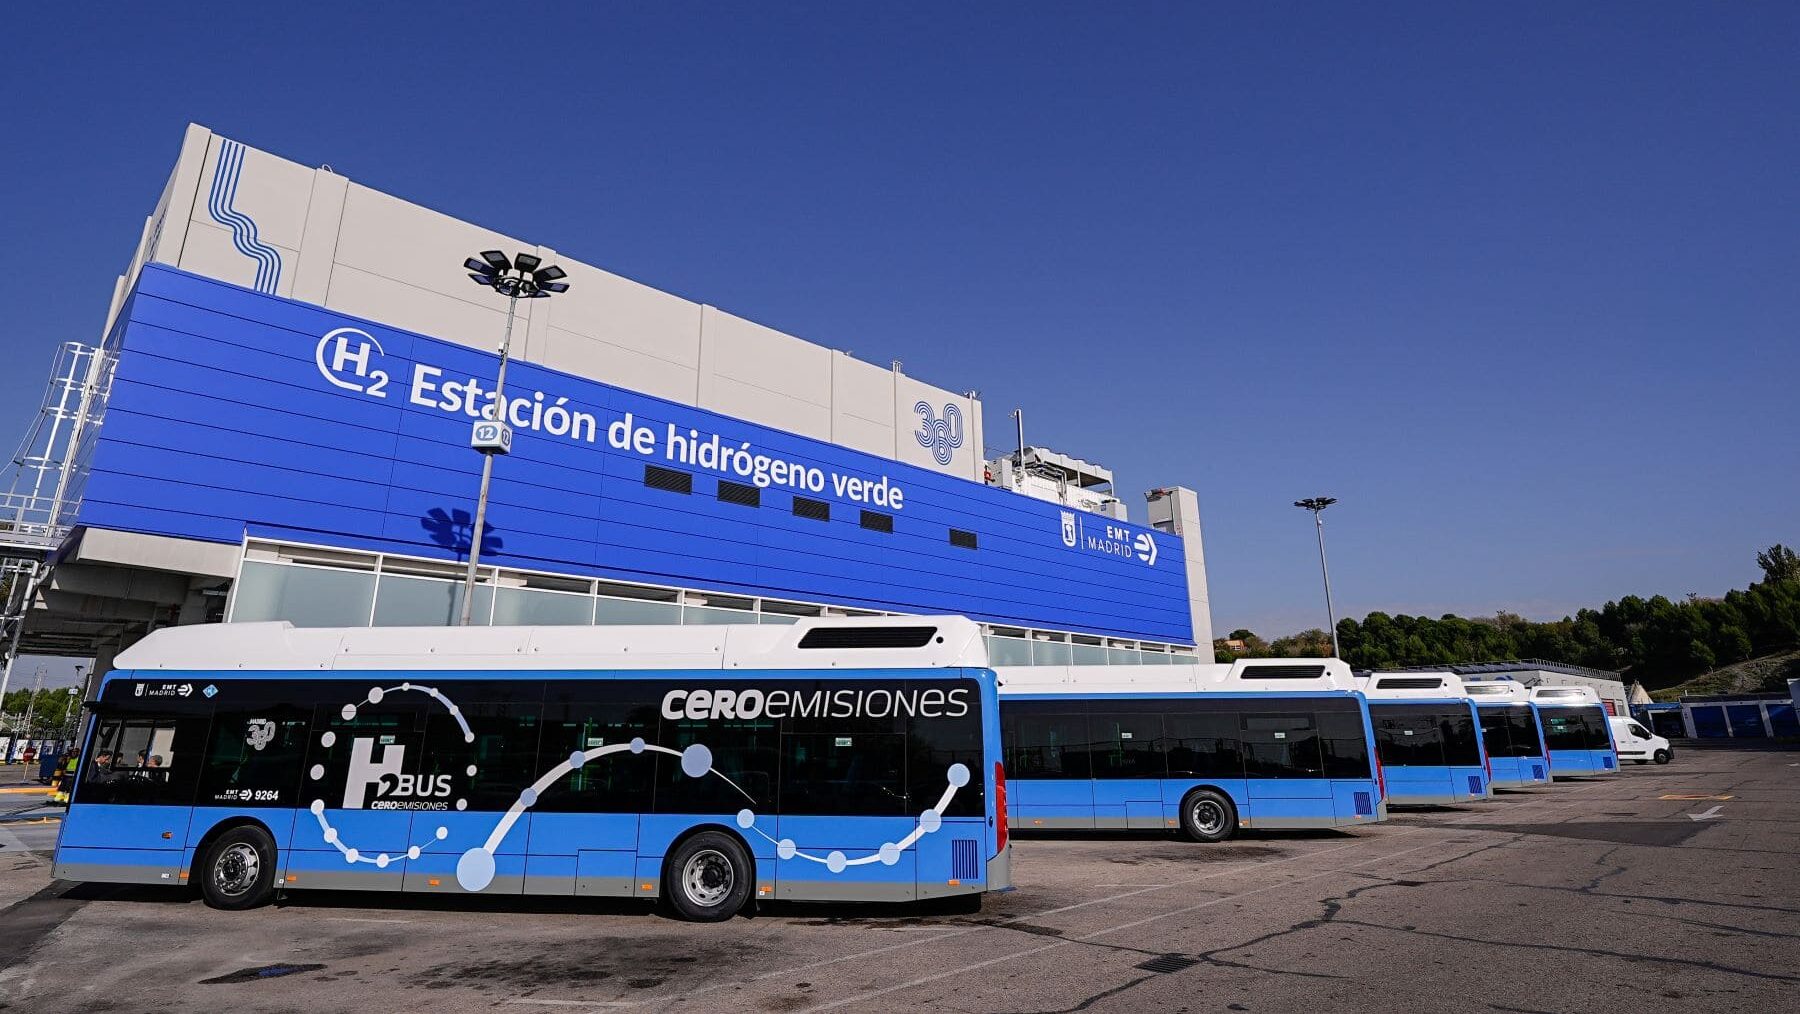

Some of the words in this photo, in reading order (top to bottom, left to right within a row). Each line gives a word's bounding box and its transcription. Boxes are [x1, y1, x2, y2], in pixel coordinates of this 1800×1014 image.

[410, 363, 597, 443] Estación
[608, 413, 655, 454] de
[666, 423, 825, 492] hidrógeno
[832, 472, 904, 510] verde
[478, 427, 494, 439] 12
[1106, 525, 1130, 542] EMT
[1088, 536, 1132, 558] MADRID
[254, 789, 279, 800] 9264
